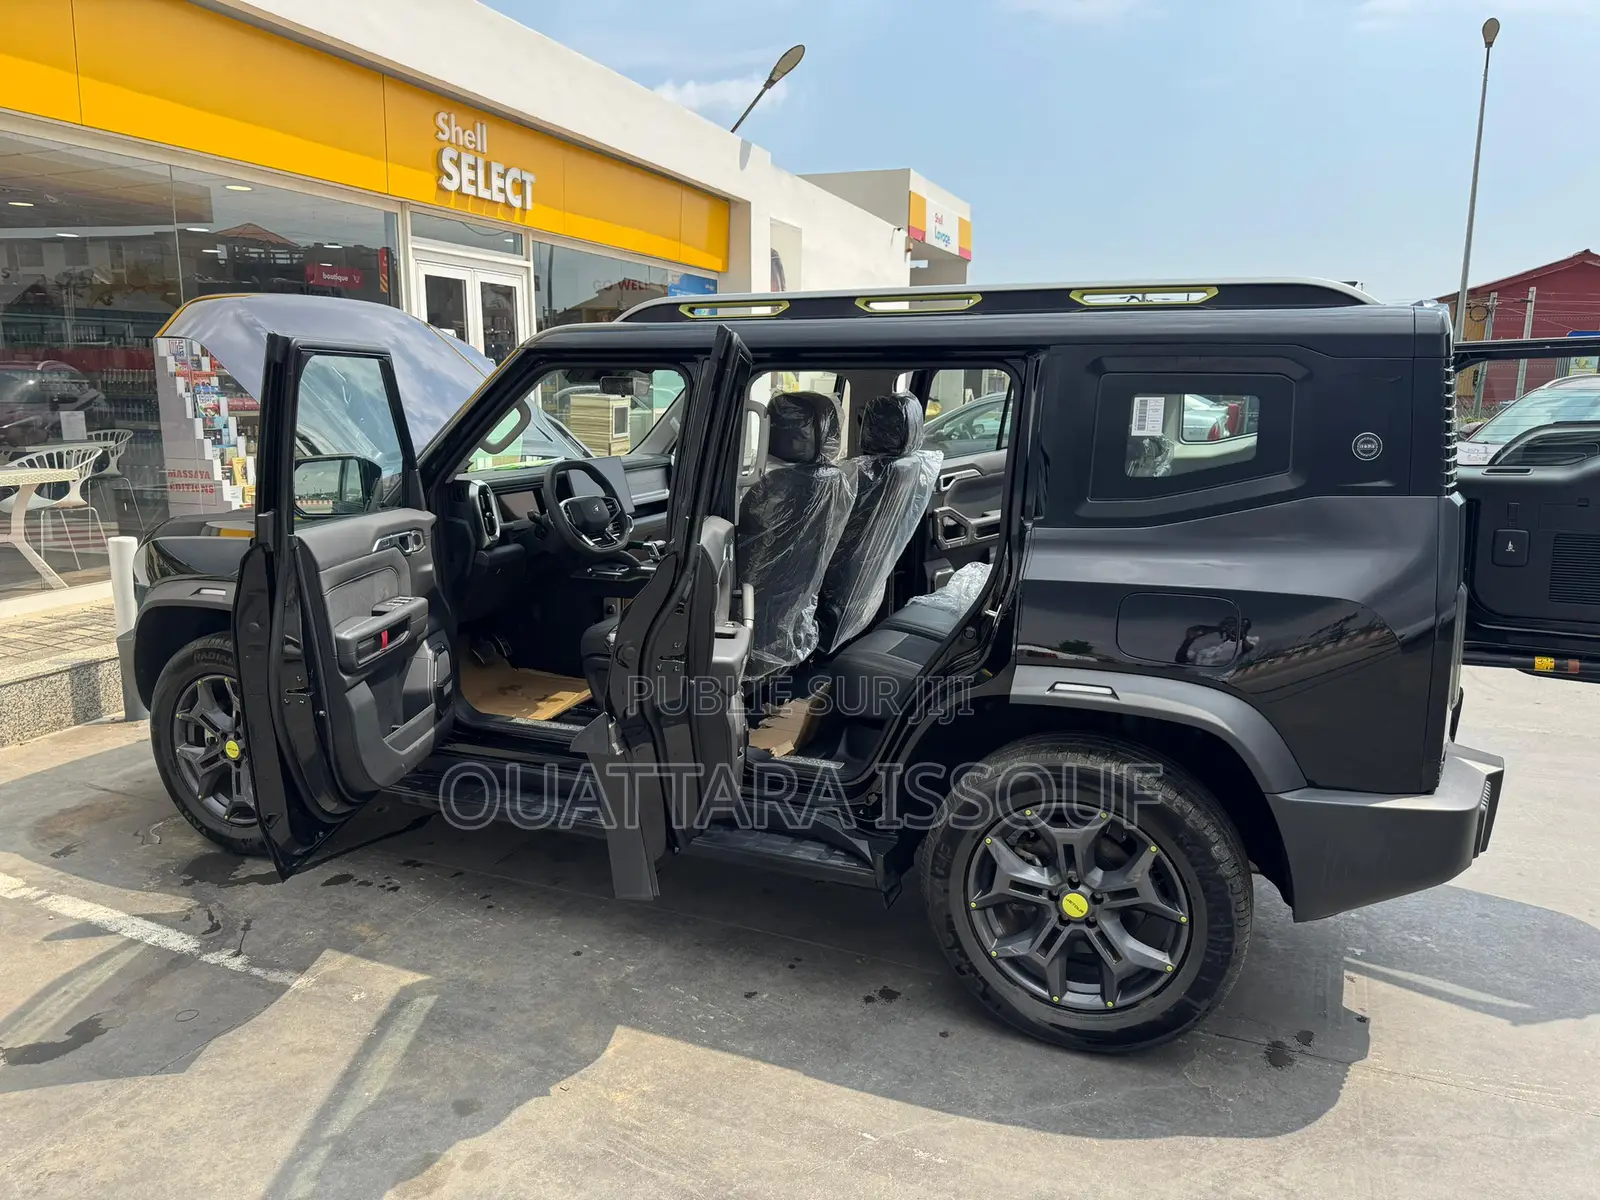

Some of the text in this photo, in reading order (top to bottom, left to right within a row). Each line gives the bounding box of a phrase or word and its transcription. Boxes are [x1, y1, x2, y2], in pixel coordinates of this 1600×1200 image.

[436, 111, 487, 155] Shell
[438, 146, 536, 210] SELECT
[322, 271, 349, 283] boutique
[167, 468, 211, 480] MASSAYA
